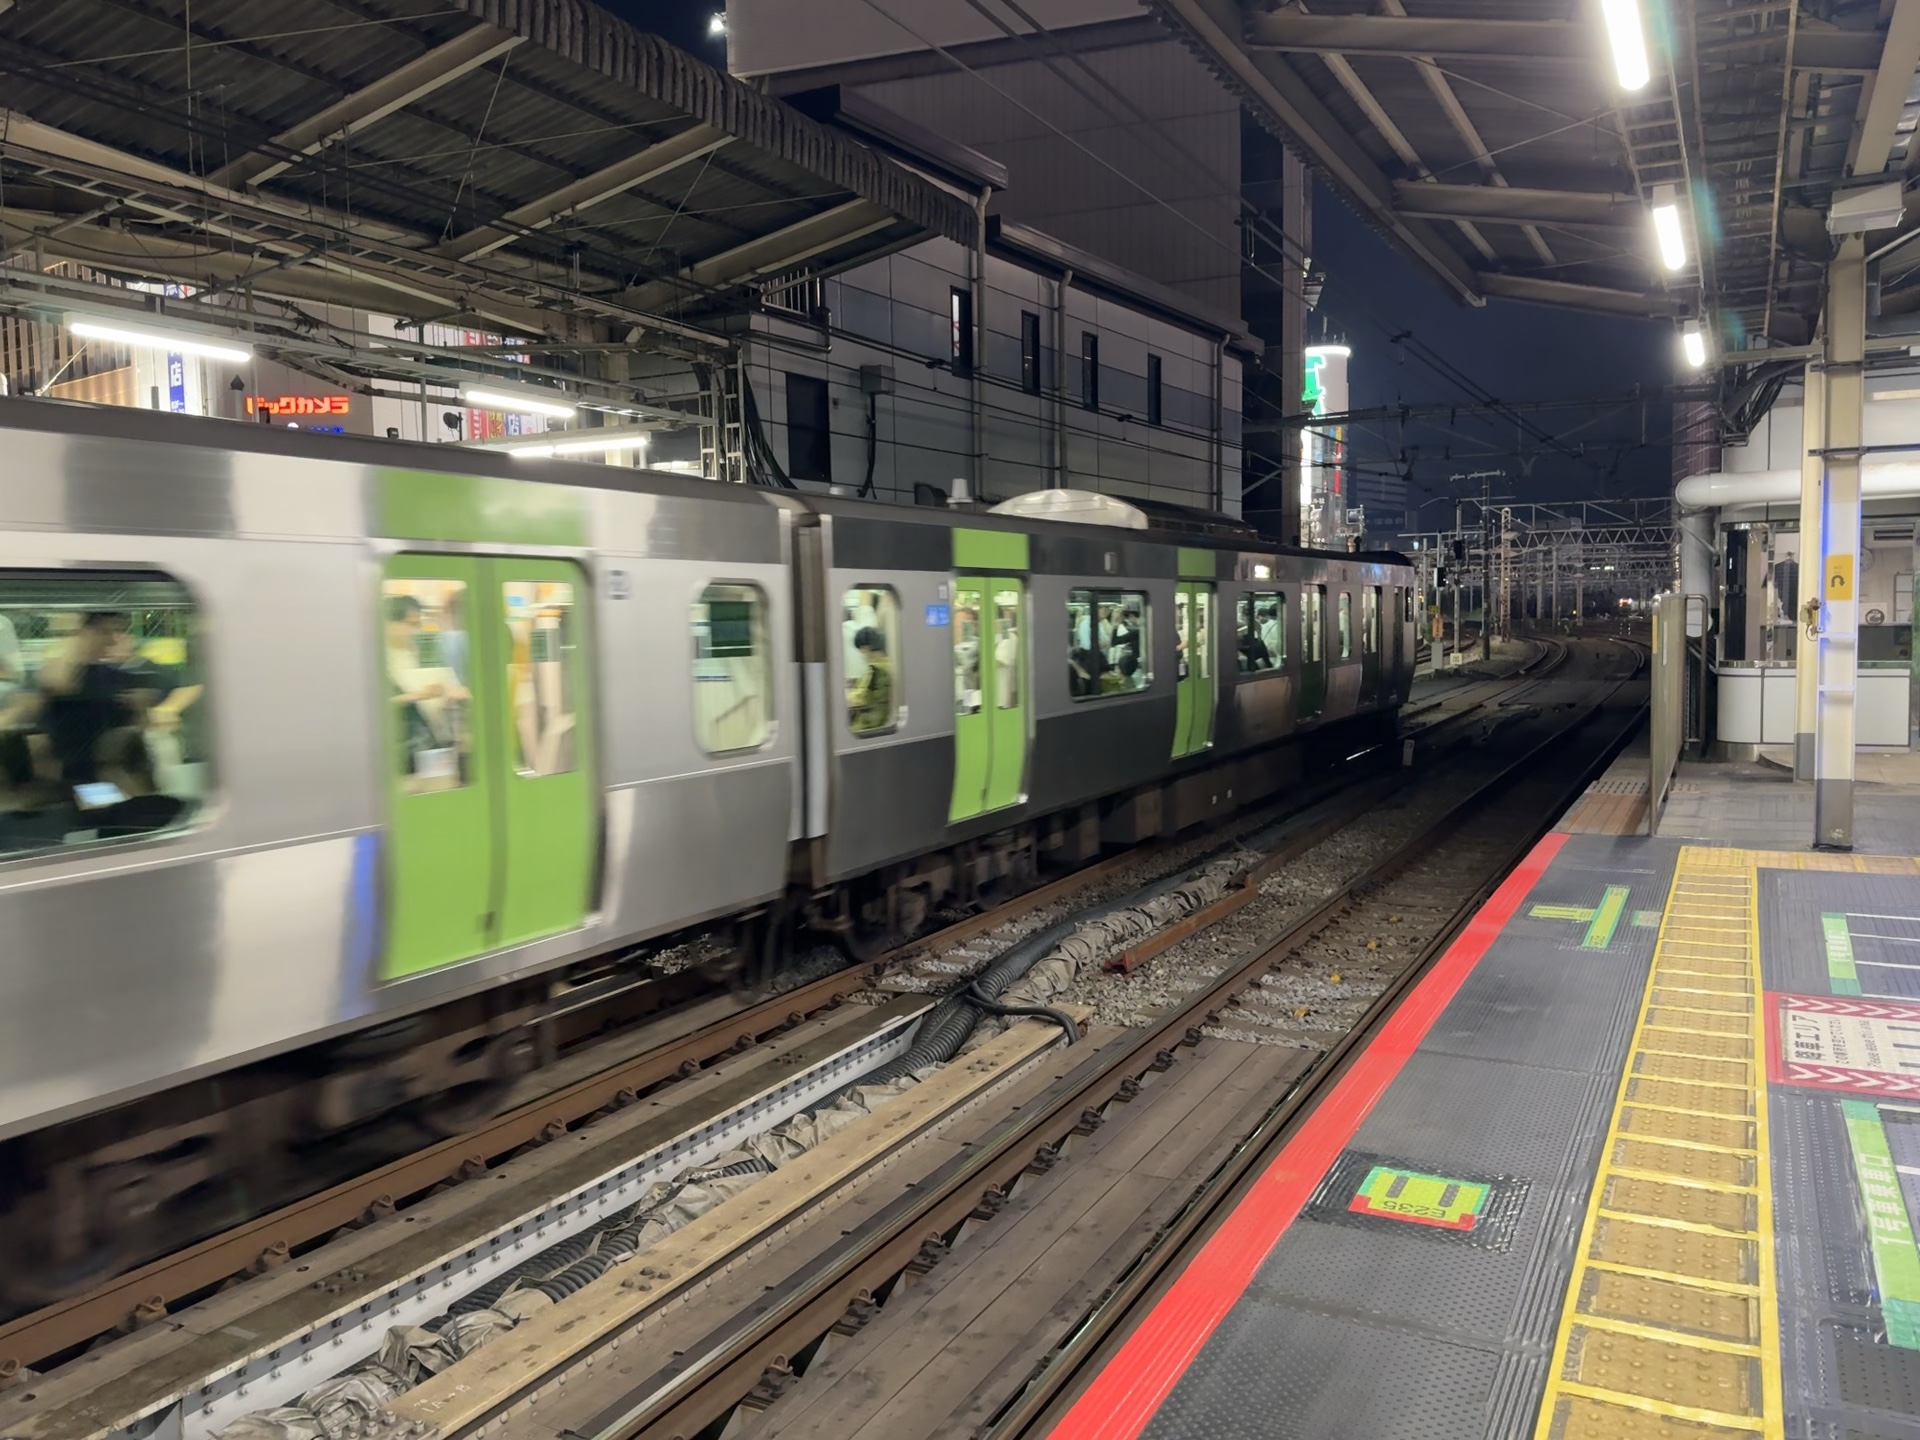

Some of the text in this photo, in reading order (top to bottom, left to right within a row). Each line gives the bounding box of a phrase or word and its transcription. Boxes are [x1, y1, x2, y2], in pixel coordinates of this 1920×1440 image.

[246, 396, 349, 415] ビックカメラ
[1791, 1015, 1826, 1061] 降車エリア
[1381, 1199, 1447, 1219] E235
[1859, 1153, 1912, 1245] 1号車乗車口
